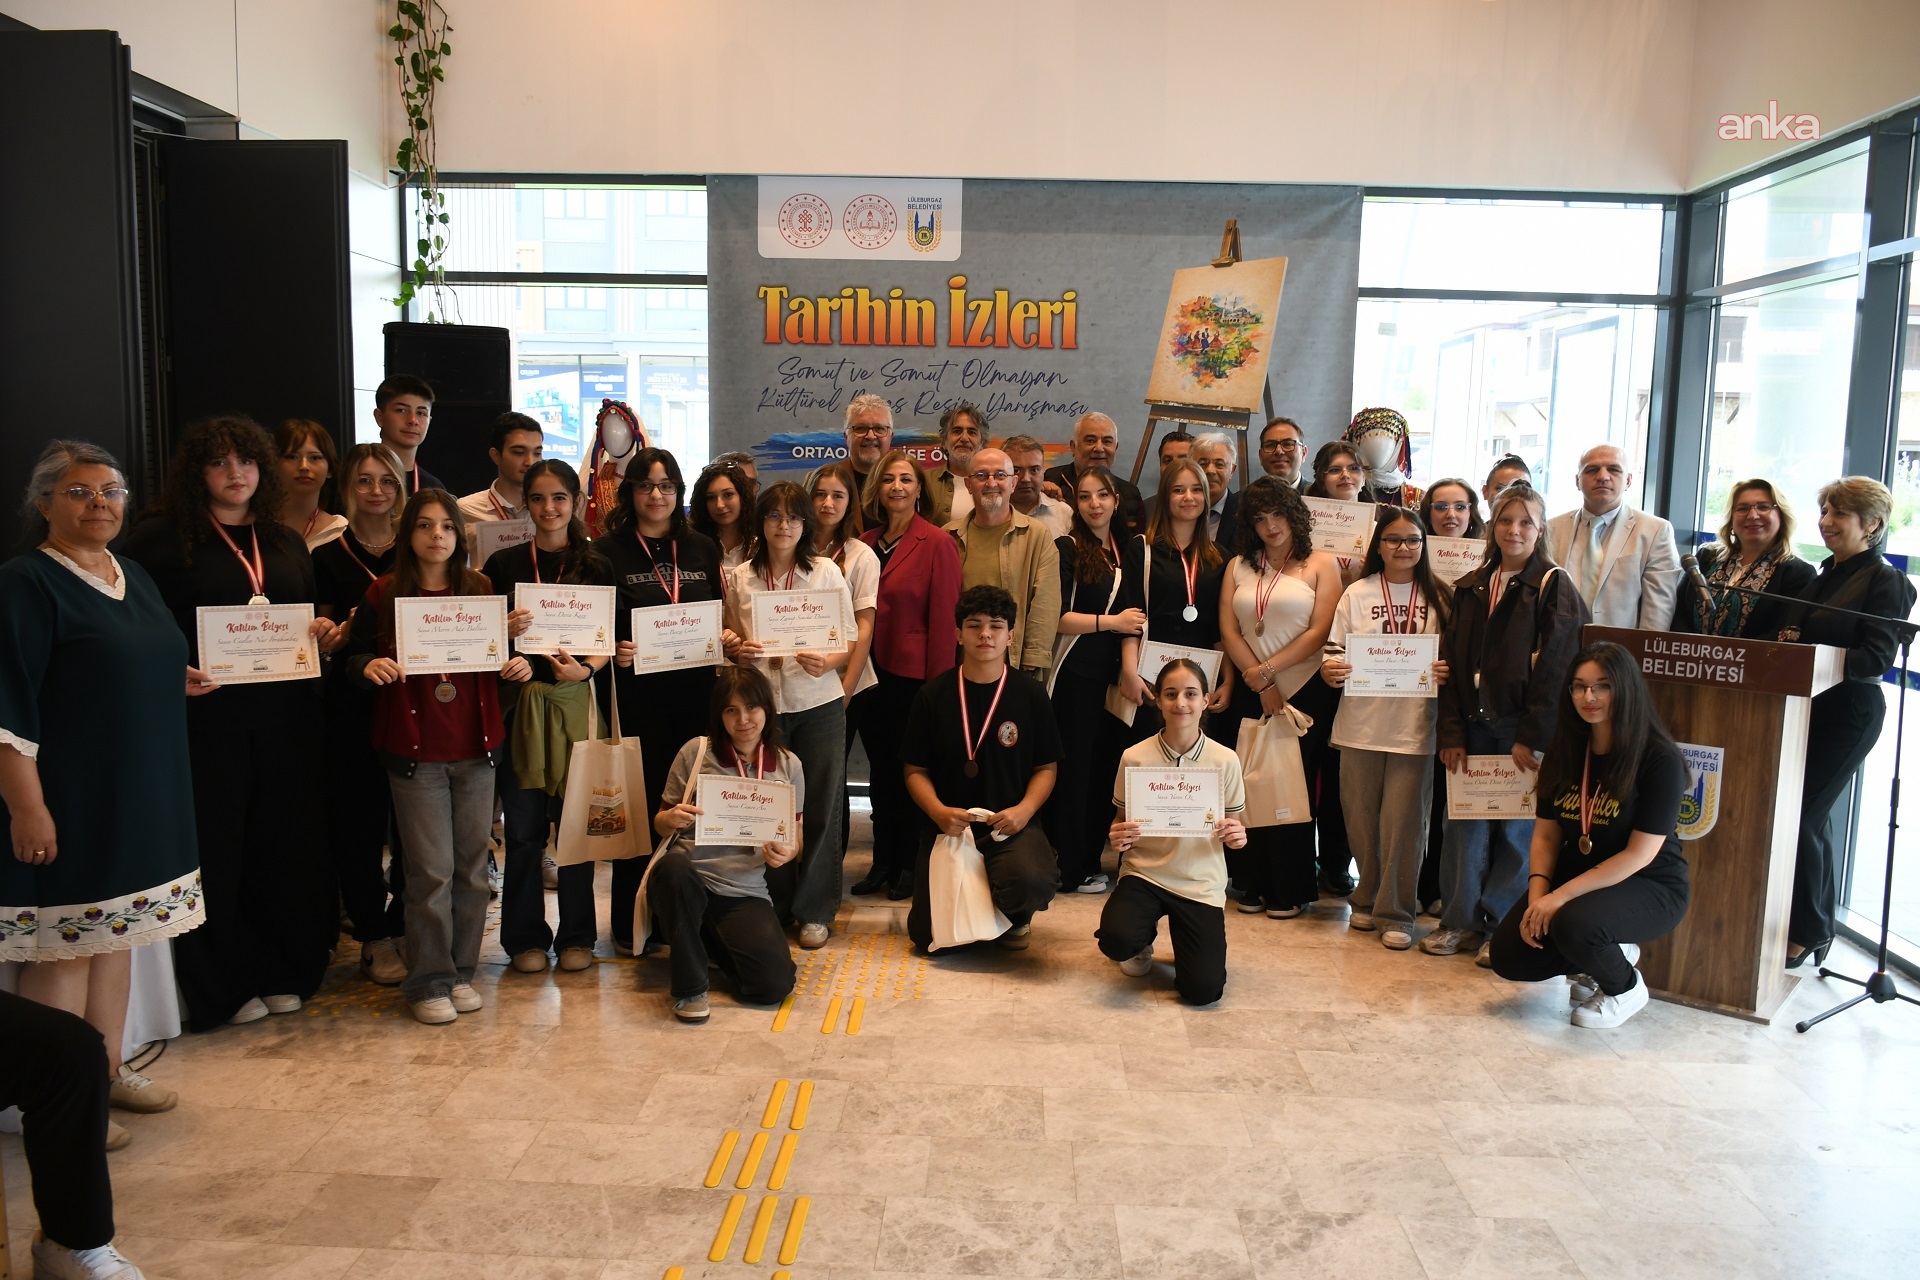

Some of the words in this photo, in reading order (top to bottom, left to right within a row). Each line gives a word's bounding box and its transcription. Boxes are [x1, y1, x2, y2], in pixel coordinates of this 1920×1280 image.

[758, 286, 936, 346] Tarihin
[948, 275, 1077, 349] İzleri
[777, 356, 852, 391] Somut
[849, 365, 875, 383] ve
[880, 358, 958, 392] Somut
[962, 358, 1068, 396] Olmayan
[757, 386, 842, 417] Kültürel
[984, 393, 1089, 422] Yarışması
[540, 599, 566, 610] Katılım
[569, 599, 592, 611] Belgesi
[774, 605, 799, 614] Katılım
[801, 602, 824, 613] Belgesi
[423, 613, 452, 624] Katılım
[455, 612, 482, 624] Belgesi
[653, 619, 678, 629] Katılım
[680, 615, 702, 626] Belgesi
[226, 622, 258, 633] Katılım
[261, 620, 289, 633] Belgesi
[1394, 646, 1417, 657] Belgesi
[1644, 637, 1746, 662] LÜLEBURGAZ
[1642, 657, 1744, 684] BELEDİYESİ
[1148, 782, 1175, 791] Katılım
[1178, 781, 1201, 793] Belgesi
[721, 790, 748, 801] Katılım
[750, 792, 774, 805] Belgesi
